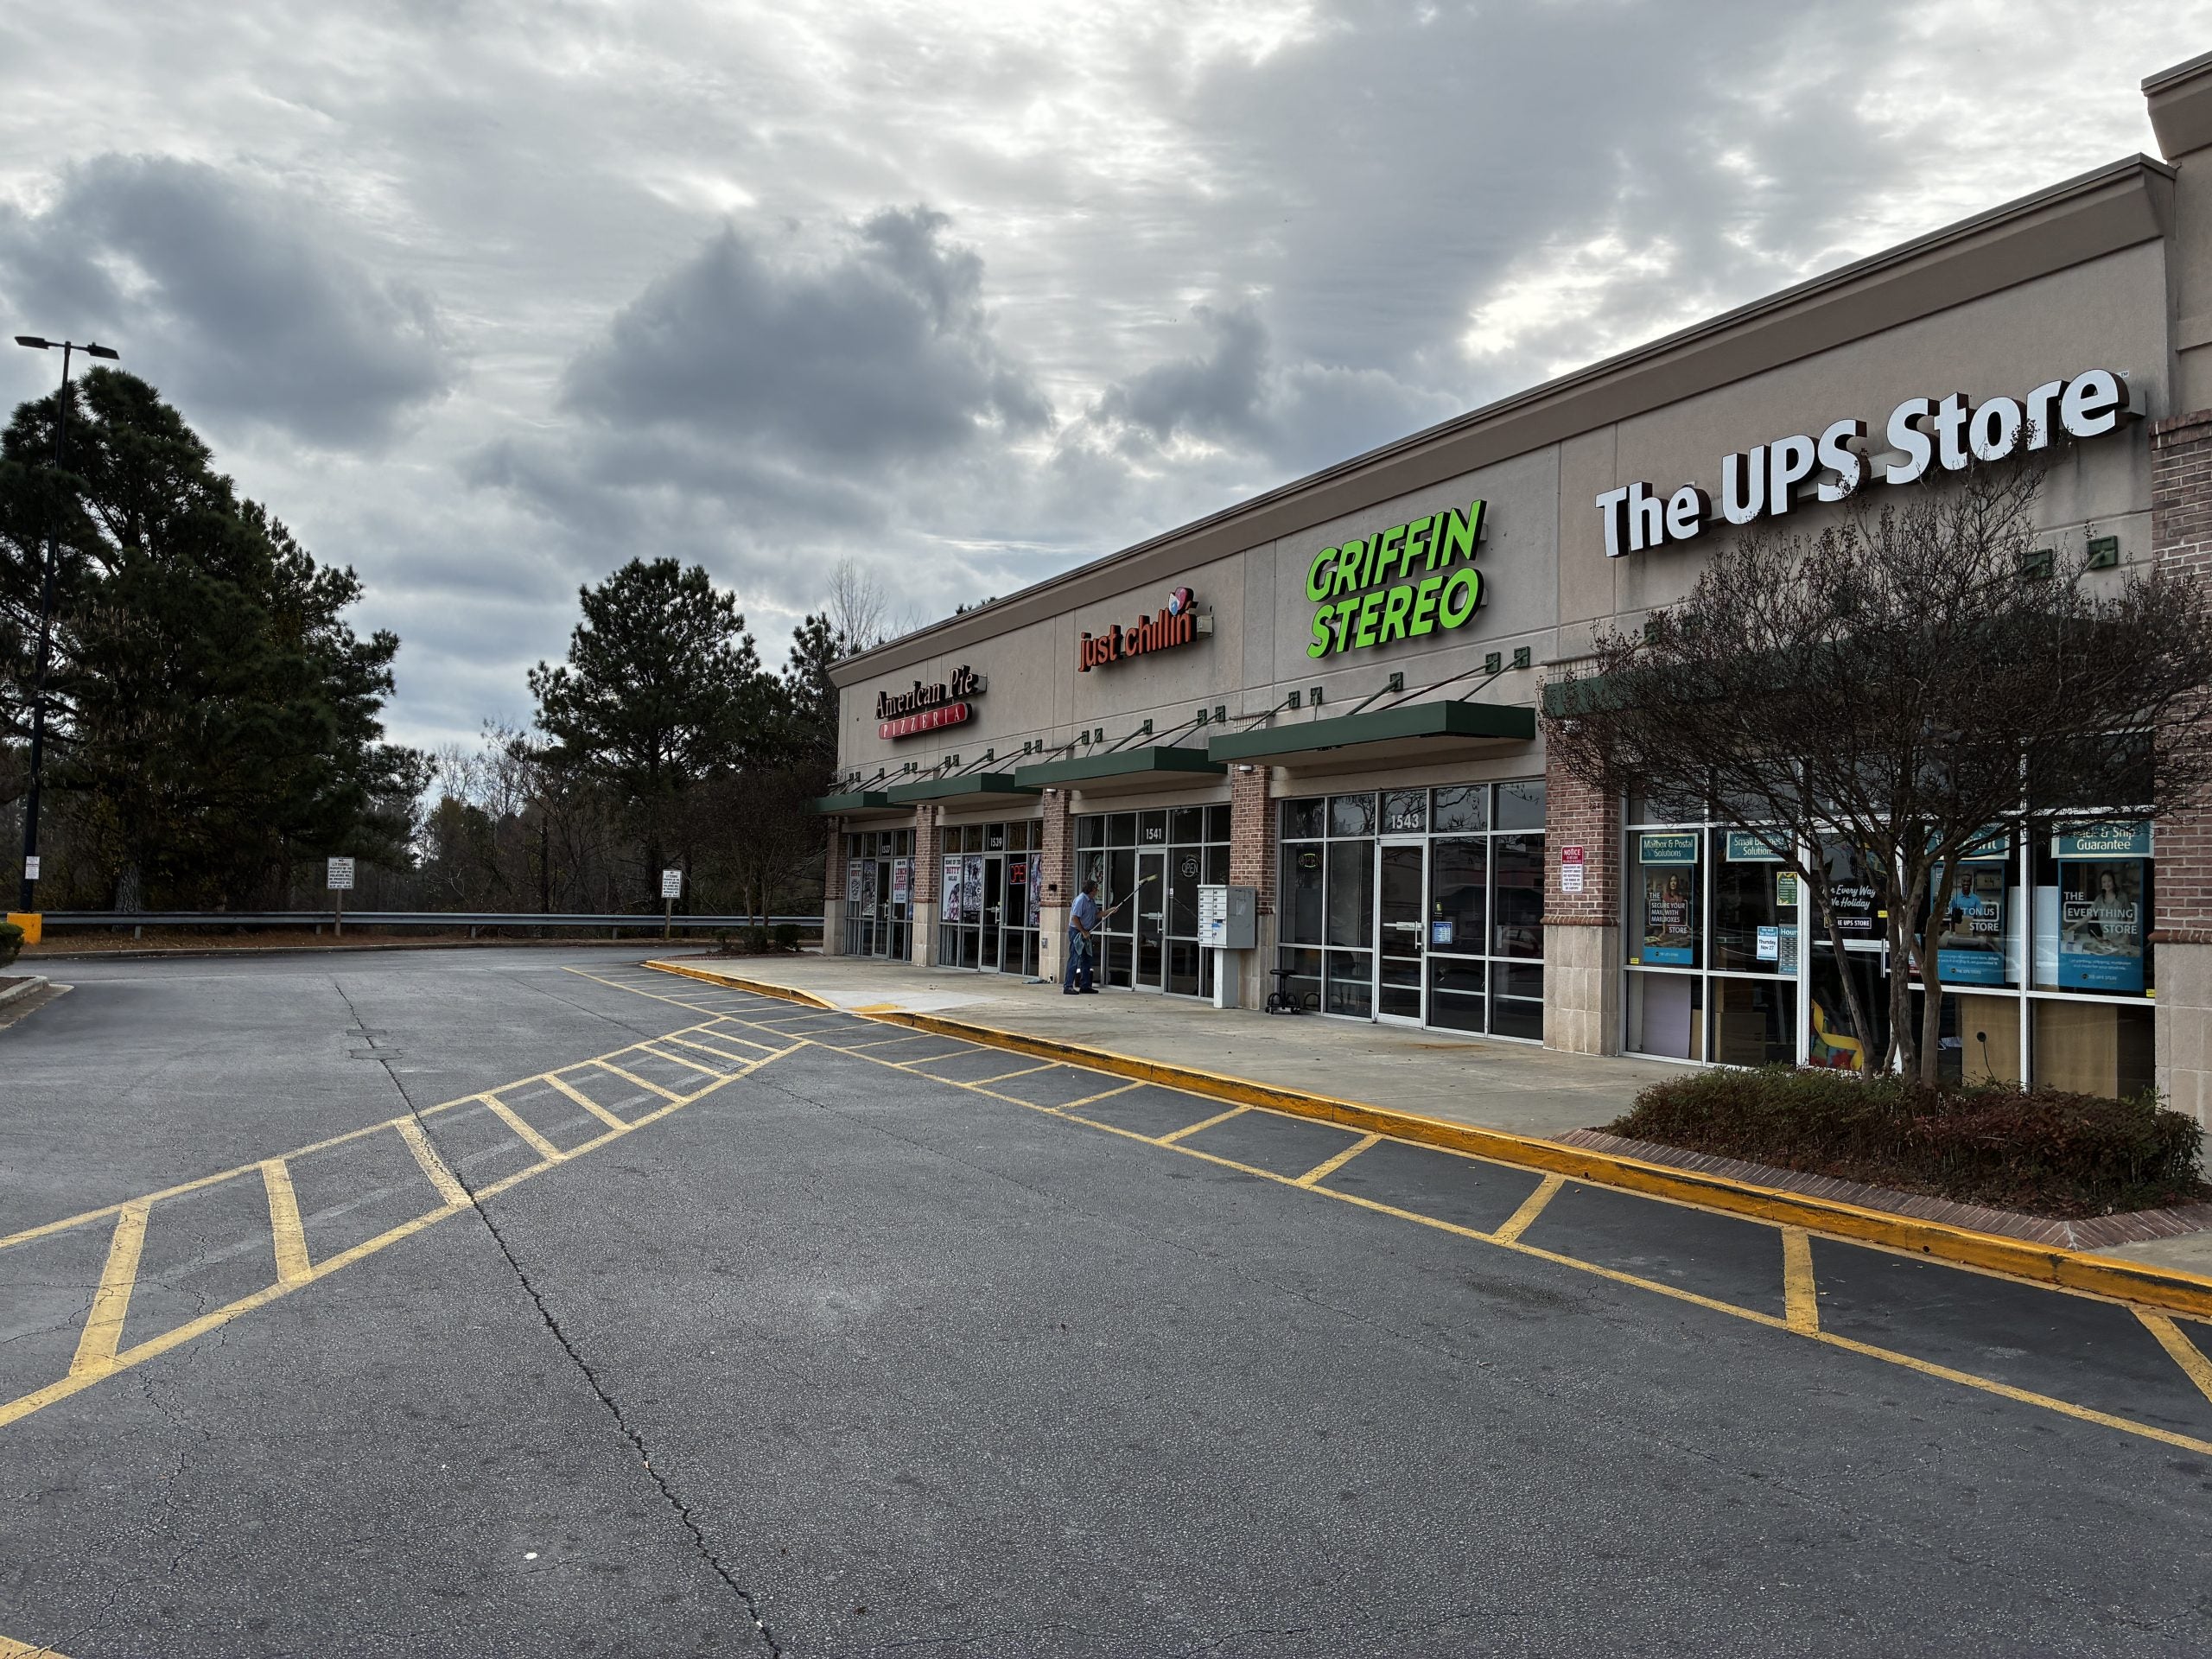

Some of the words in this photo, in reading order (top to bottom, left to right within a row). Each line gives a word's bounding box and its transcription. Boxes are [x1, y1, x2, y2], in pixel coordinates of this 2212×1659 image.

[1595, 481, 1700, 558] The
[1721, 418, 1863, 525] UPS
[1885, 368, 2121, 485] Store
[1306, 499, 1482, 602] GRIFFIN
[1306, 567, 1480, 659] STEREO
[1078, 625, 1118, 672] just
[874, 680, 941, 720] American
[949, 664, 974, 698] Pie
[883, 706, 961, 738] PIZZERIA
[1391, 813, 1419, 830] 1543
[1146, 827, 1162, 840] 1541
[990, 837, 1002, 847] 1539
[1643, 839, 1668, 849] Mailbox
[1669, 839, 1674, 849] &
[1675, 839, 1694, 848] Postal
[1734, 836, 1753, 846] Small
[2076, 839, 2131, 850] Guarantee
[1743, 846, 1776, 856] Solution
[1182, 862, 1198, 874] OPEN
[1836, 885, 1859, 898] Every
[1859, 885, 1877, 899] Way
[2063, 891, 2084, 900] THE
[1840, 897, 1871, 910] Holiday
[1968, 907, 1982, 916] ON
[1983, 907, 1995, 916] US
[2068, 907, 2133, 918] EVERYTHING
[1969, 922, 1999, 931] STORE
[2103, 924, 2138, 934] STORE
